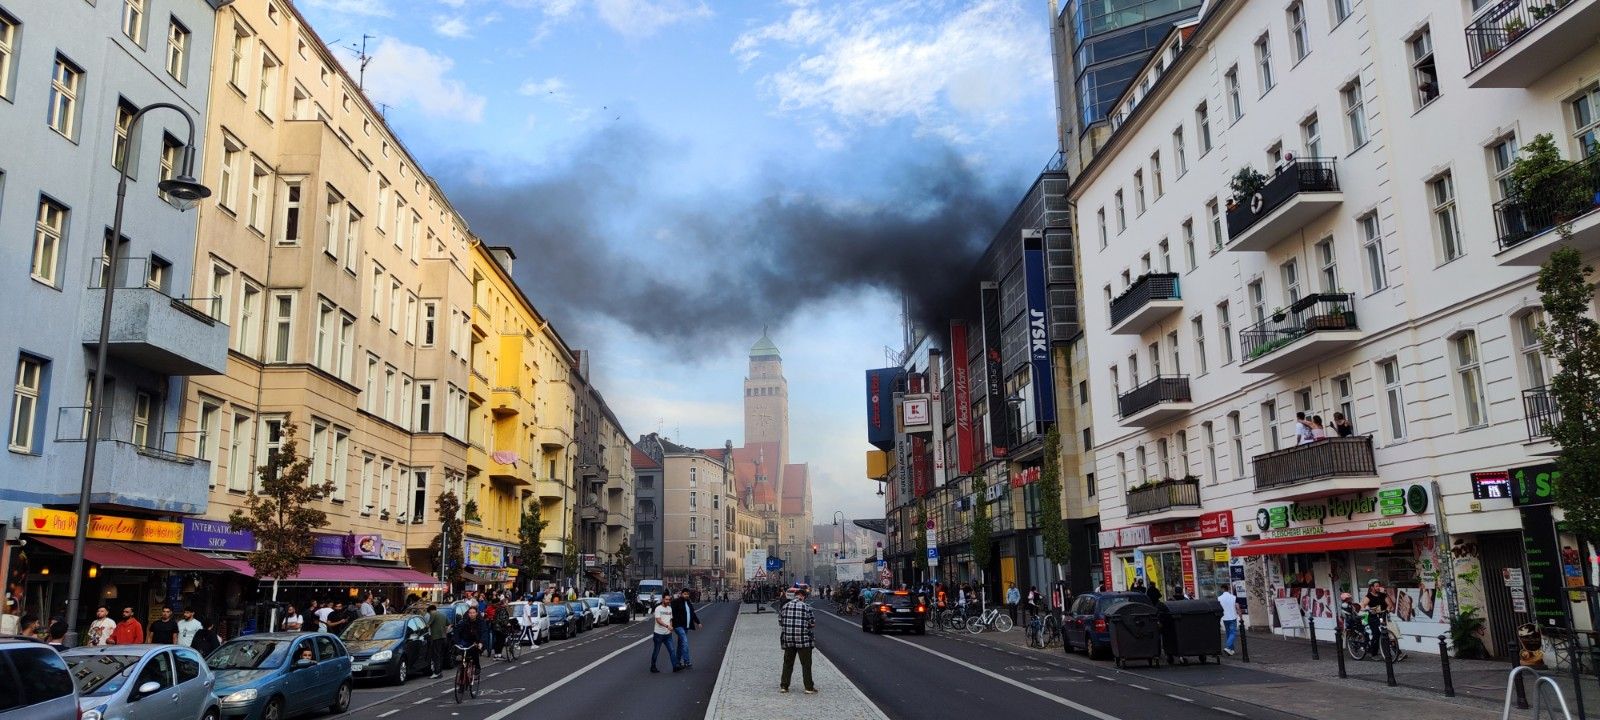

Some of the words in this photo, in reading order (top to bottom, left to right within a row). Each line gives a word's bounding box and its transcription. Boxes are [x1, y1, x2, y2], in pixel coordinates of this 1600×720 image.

[1030, 308, 1046, 352] JYSK
[1289, 502, 1325, 524] Kasap
[1303, 527, 1324, 536] HAYDAR
[208, 537, 227, 547] SHOP
